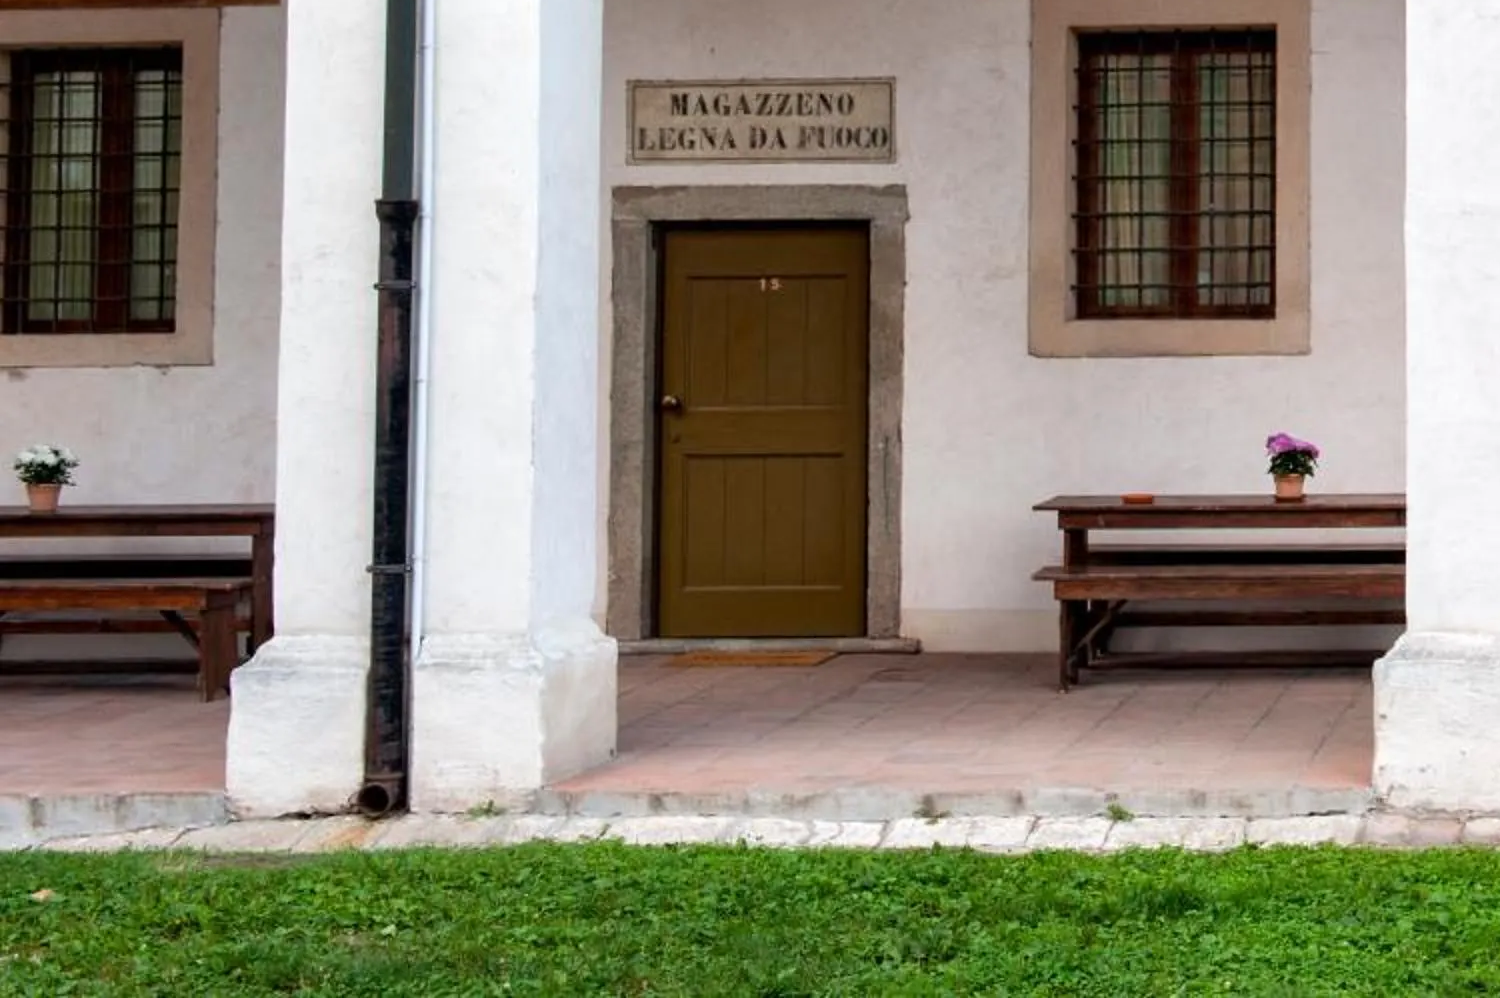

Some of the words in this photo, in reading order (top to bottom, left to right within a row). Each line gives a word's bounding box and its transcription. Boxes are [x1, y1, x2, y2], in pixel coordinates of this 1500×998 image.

[669, 92, 856, 116] MAGAZZENO
[638, 126, 737, 151] LEGNA
[748, 125, 788, 150] DA
[797, 125, 889, 150] FUOCO
